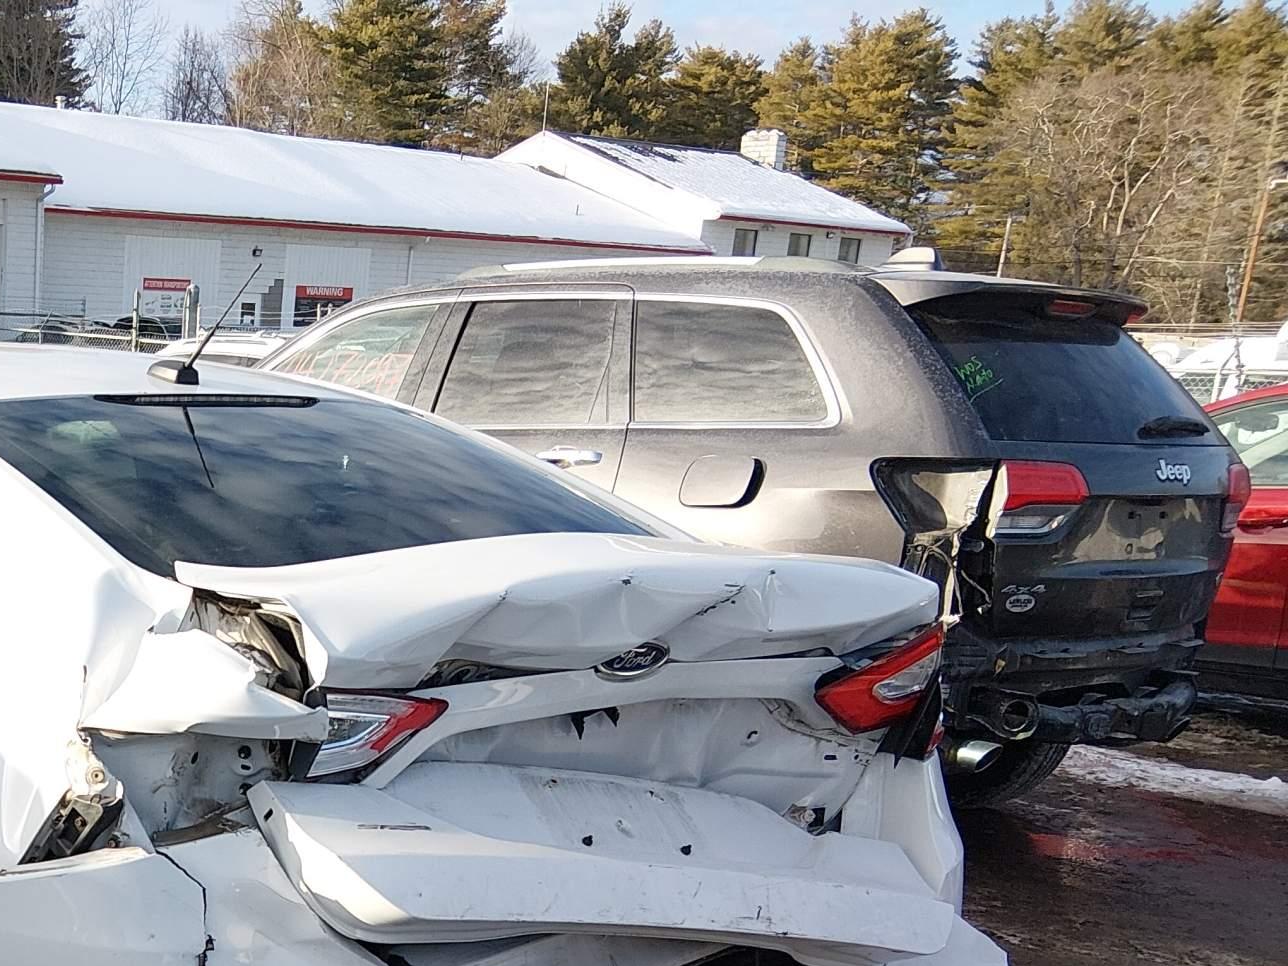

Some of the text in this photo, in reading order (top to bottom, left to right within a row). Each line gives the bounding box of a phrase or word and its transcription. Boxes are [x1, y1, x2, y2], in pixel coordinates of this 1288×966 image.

[306, 286, 344, 297] WARNING
[1155, 459, 1191, 485] Jeep
[613, 647, 657, 668] Ford
